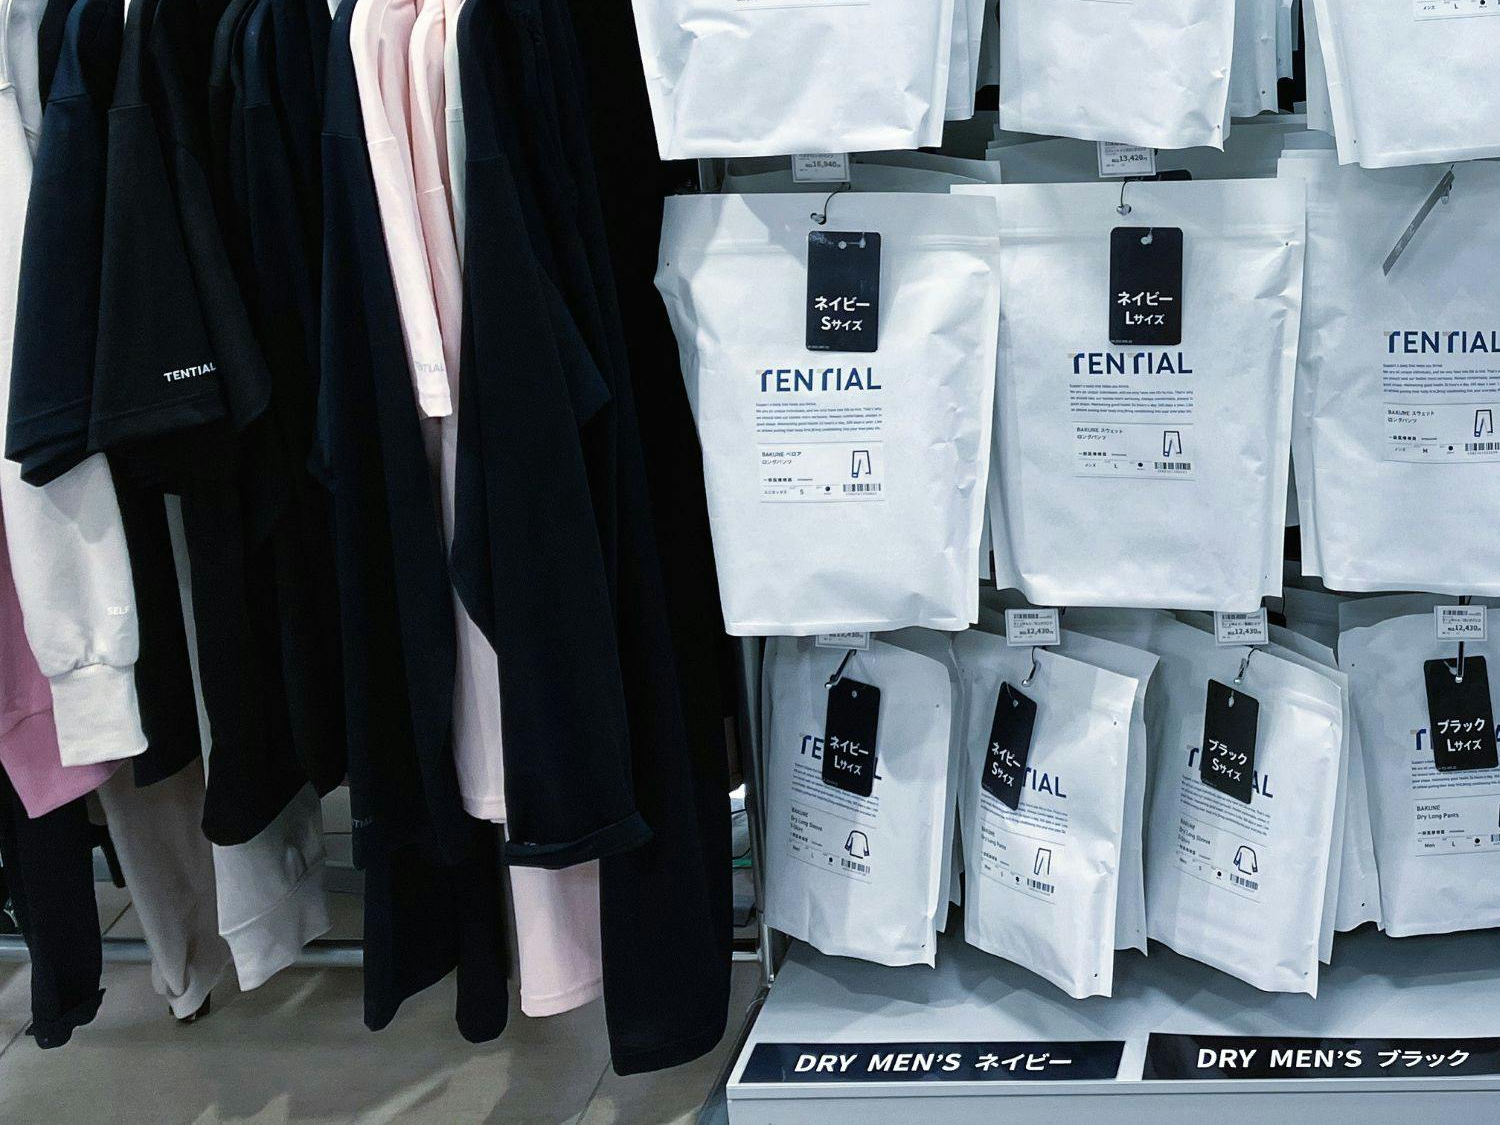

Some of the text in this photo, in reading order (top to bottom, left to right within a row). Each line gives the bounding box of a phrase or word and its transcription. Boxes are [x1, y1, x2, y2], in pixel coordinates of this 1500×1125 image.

[814, 296, 870, 311] ネイビー
[1118, 292, 1173, 307] ネイビー
[821, 316, 863, 331] Sサイズ
[1125, 311, 1165, 325] Lサイズ
[163, 362, 216, 382] TENTIAL
[1068, 352, 1193, 375] TENTIAL
[756, 368, 882, 393] TENTIAL
[1437, 717, 1485, 735] ブラック
[829, 735, 869, 757] ネイビー
[991, 741, 1021, 769] ネイビー
[1208, 738, 1248, 766] ブラック
[1447, 738, 1482, 752] Lサイズ
[834, 755, 862, 775] Lサイズ
[992, 761, 1015, 787] Sサイズ
[1212, 758, 1242, 783] Sサイズ
[794, 1052, 857, 1073] DRY
[975, 1052, 1073, 1072] ネイビー
[1196, 1047, 1259, 1070] DRY
[1377, 1047, 1471, 1069] ブラック
